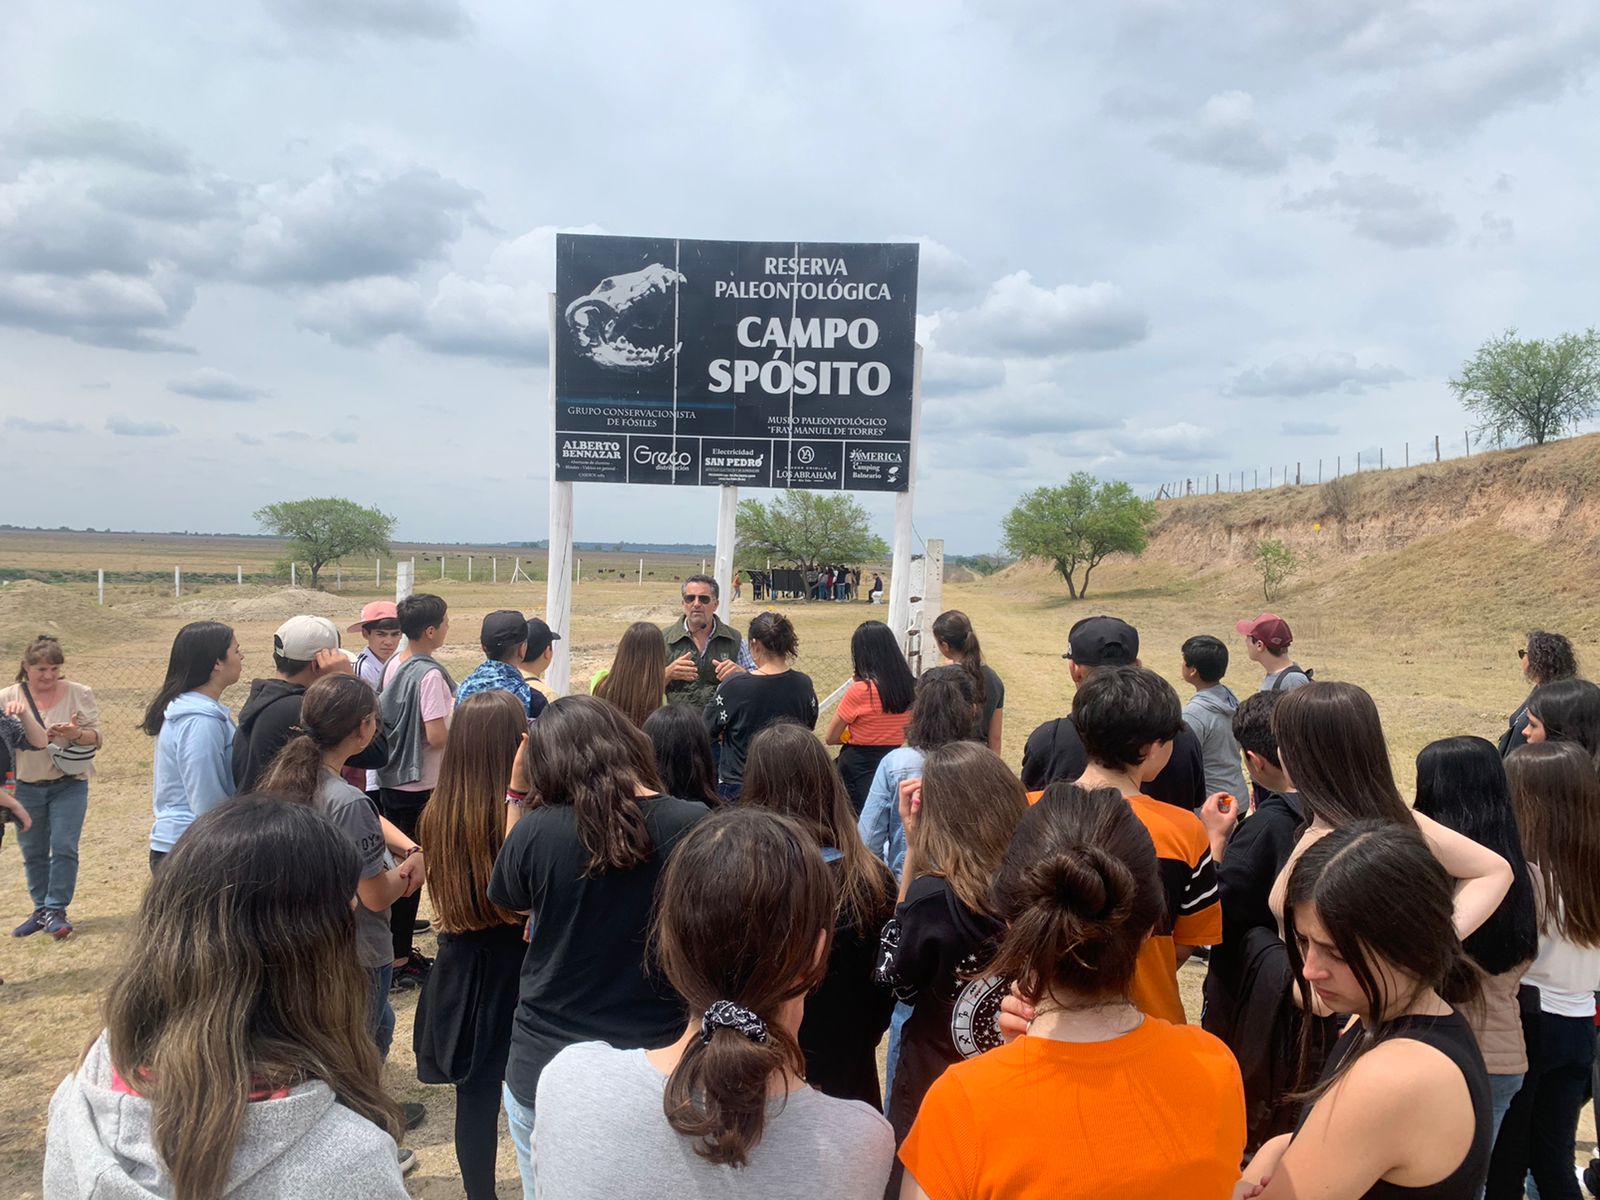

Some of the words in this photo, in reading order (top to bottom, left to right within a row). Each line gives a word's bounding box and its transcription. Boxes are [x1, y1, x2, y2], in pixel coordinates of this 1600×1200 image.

[764, 257, 848, 275] RESERVA
[714, 278, 892, 300] PALEONTOLÓGICA
[736, 316, 879, 349] CAMPO
[708, 350, 891, 396] SPÓSITO
[567, 406, 601, 415] GRUPO
[602, 408, 697, 419] CONSERVACIONISTA
[607, 418, 620, 426] DE
[622, 418, 657, 428] FÓSILES
[767, 416, 800, 425] MUSEO
[801, 416, 887, 426] PALEONTOLÓGICO
[794, 426, 832, 435] MANUEL
[833, 427, 846, 435] DE
[562, 440, 620, 451] ALBERTO
[562, 450, 621, 459] BENNAZAR
[633, 445, 691, 466] Greco
[705, 457, 724, 466] SAN
[726, 456, 763, 467] PEDRO
[852, 462, 881, 472] Camping
[776, 469, 793, 479] LOS
[793, 471, 837, 480] ABRAHAM
[852, 471, 882, 479] Balneario
